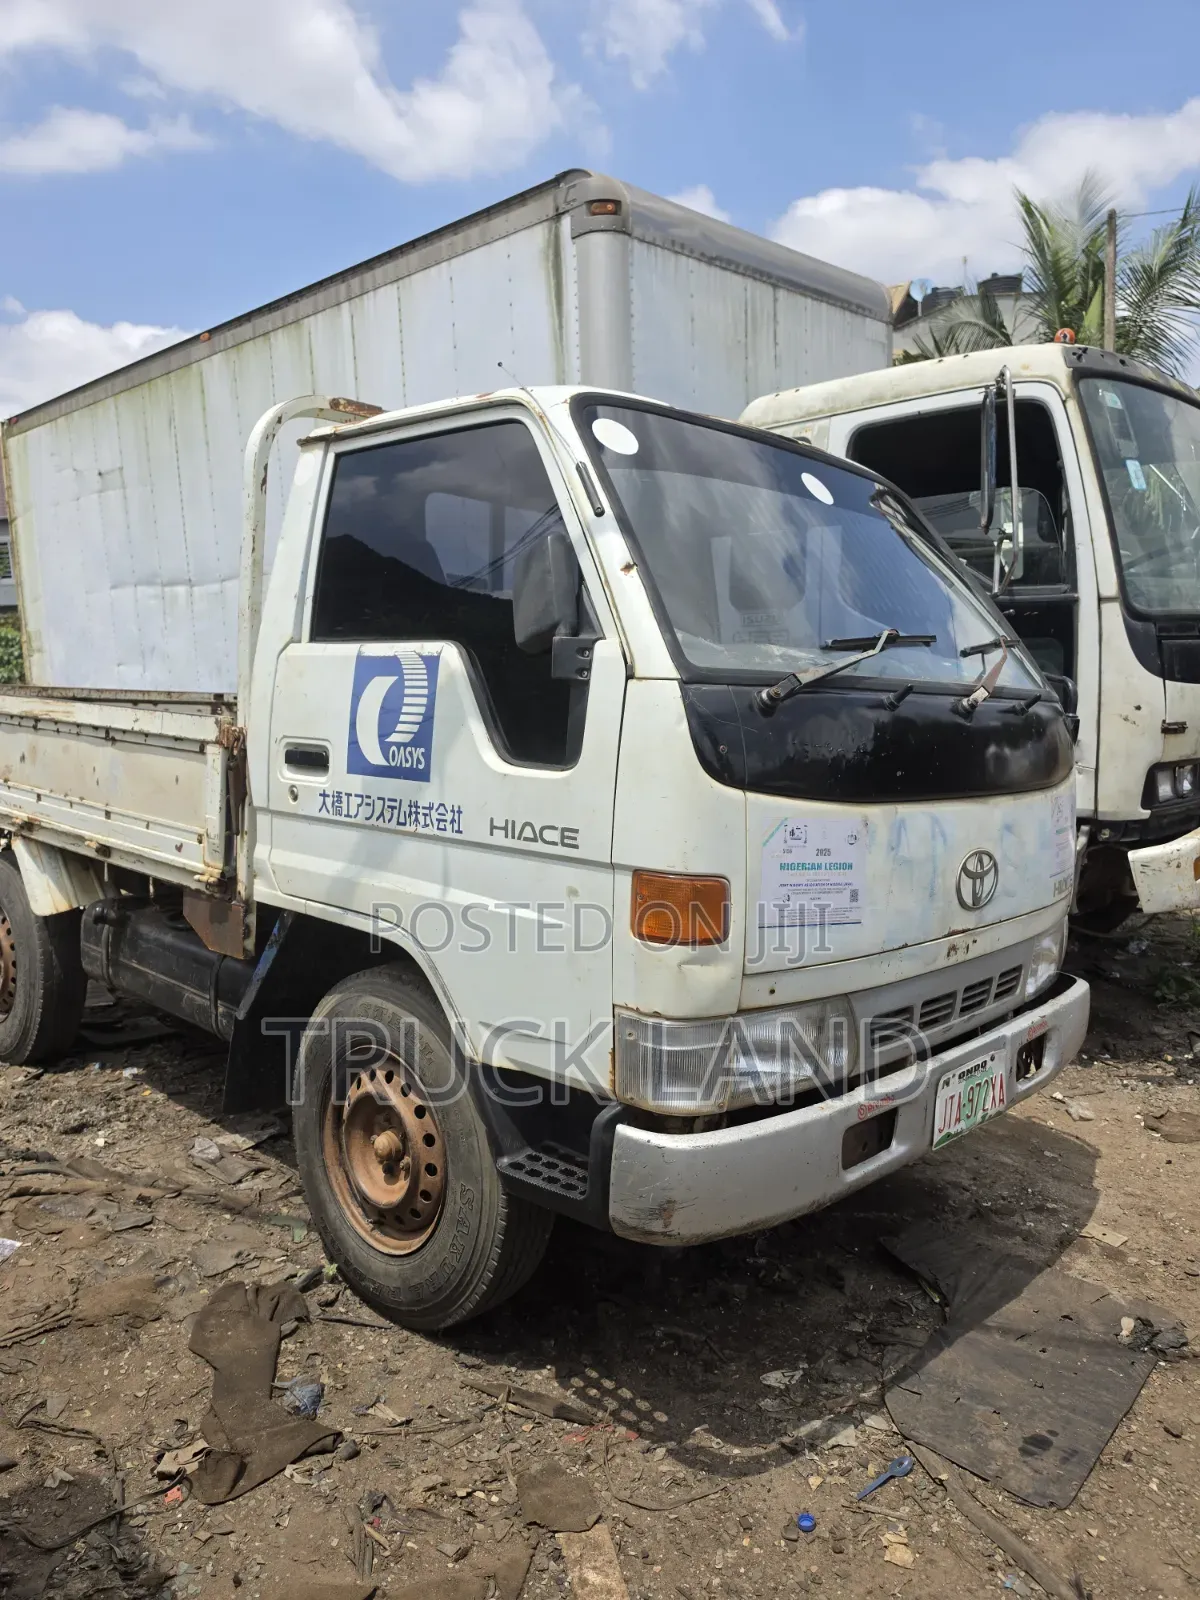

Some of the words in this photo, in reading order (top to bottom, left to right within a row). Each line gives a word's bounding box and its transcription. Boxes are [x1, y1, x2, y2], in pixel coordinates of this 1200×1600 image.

[389, 745, 425, 770] OASYS
[318, 789, 463, 834] 大橋エアシステム株式会社
[489, 817, 579, 849] HIACE
[815, 848, 832, 857] 2025
[779, 862, 822, 871] NIGERIAN
[824, 862, 853, 871] LEGION
[958, 1060, 987, 1080] ONDO
